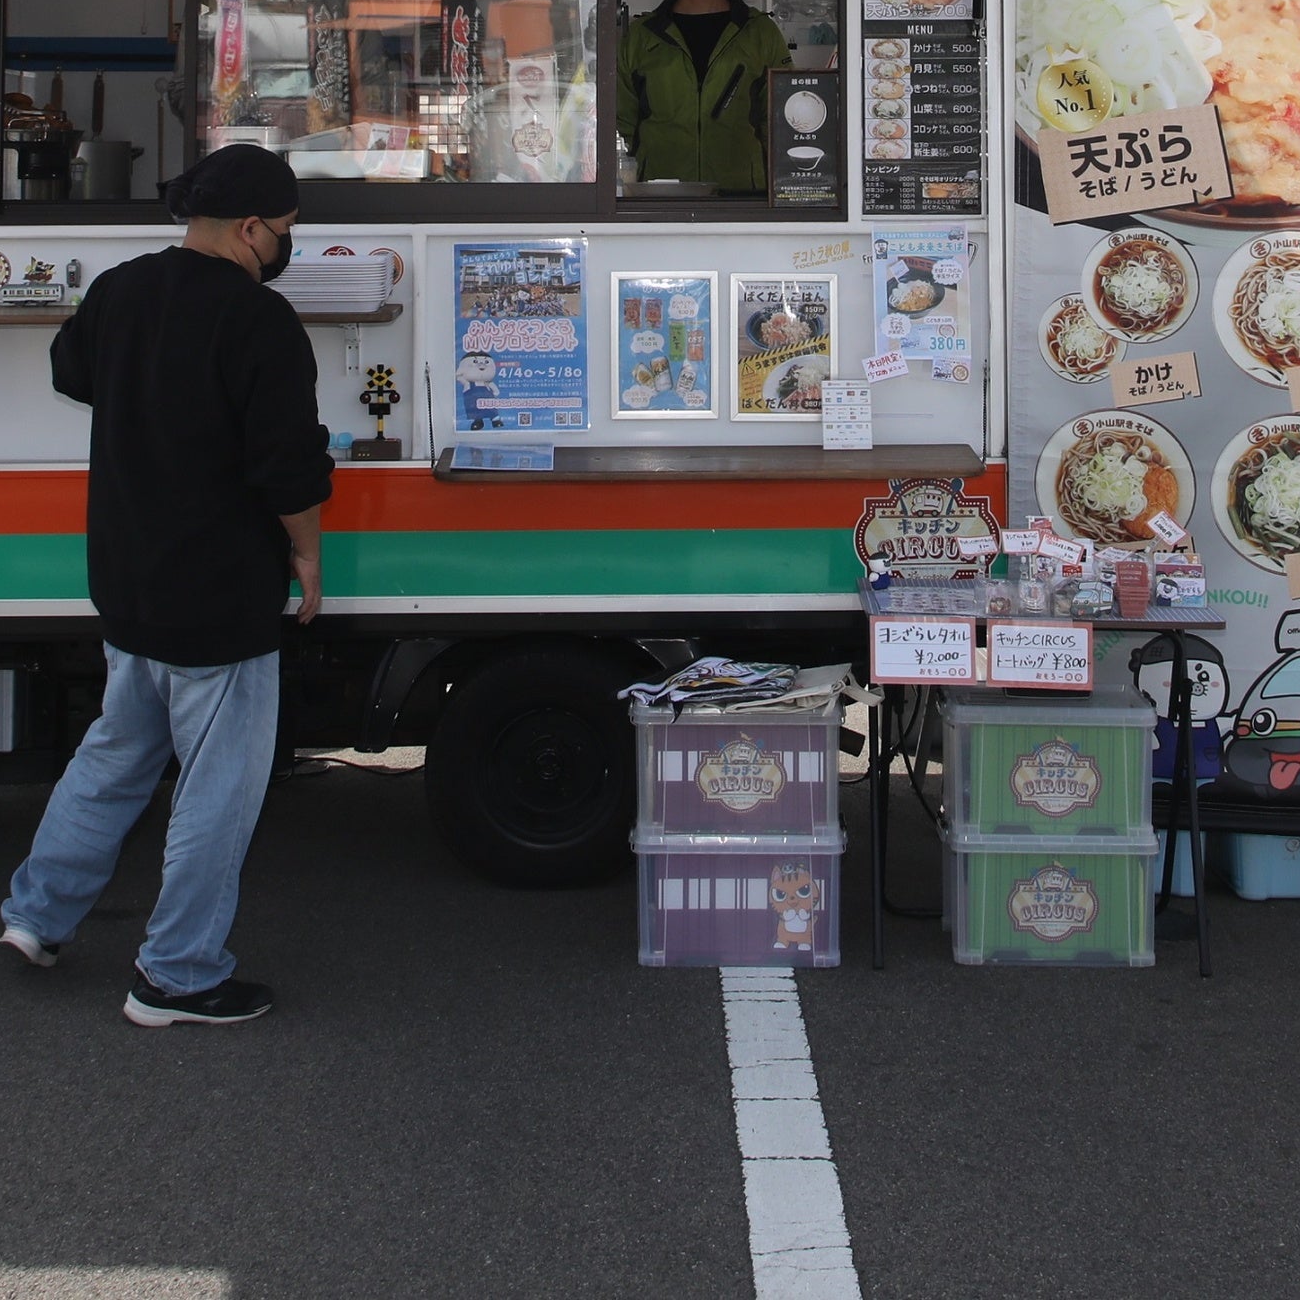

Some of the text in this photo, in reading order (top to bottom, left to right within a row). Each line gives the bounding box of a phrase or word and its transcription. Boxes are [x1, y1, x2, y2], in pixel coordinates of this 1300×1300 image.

[866, 2, 911, 18] 天ぷら
[907, 25, 933, 35] MENU
[913, 44, 931, 53] かけ
[913, 64, 933, 73] 月見
[1058, 69, 1090, 88] 人気
[913, 84, 938, 93] きつね
[913, 104, 933, 113] 山菜
[1054, 88, 1098, 116] No.1
[913, 124, 939, 133] コロッケ
[1066, 124, 1194, 179] 天ぷら
[865, 165, 900, 174] トッピング
[889, 241, 963, 251] こども未来きそば
[1125, 232, 1170, 248] 小山駅きそば
[469, 320, 574, 336] みんなとつくる
[464, 335, 578, 351] MVプロジェクト
[930, 336, 966, 350] 380円
[1135, 363, 1173, 385] かけ
[1096, 419, 1155, 437] 小山駅きそば
[898, 519, 960, 535] キッチン
[878, 625, 970, 644] ヨシざらしタオル
[996, 631, 1076, 648] キッチンCIRCUS
[996, 653, 1049, 669] トートバッグ
[721, 764, 761, 776] キッチン
[1036, 768, 1076, 779] キッチン
[708, 776, 775, 794] CIRCUS
[1023, 779, 1089, 799] CIRCUS
[1033, 893, 1074, 904] キッチン
[1020, 904, 1086, 923] CIRCUS
